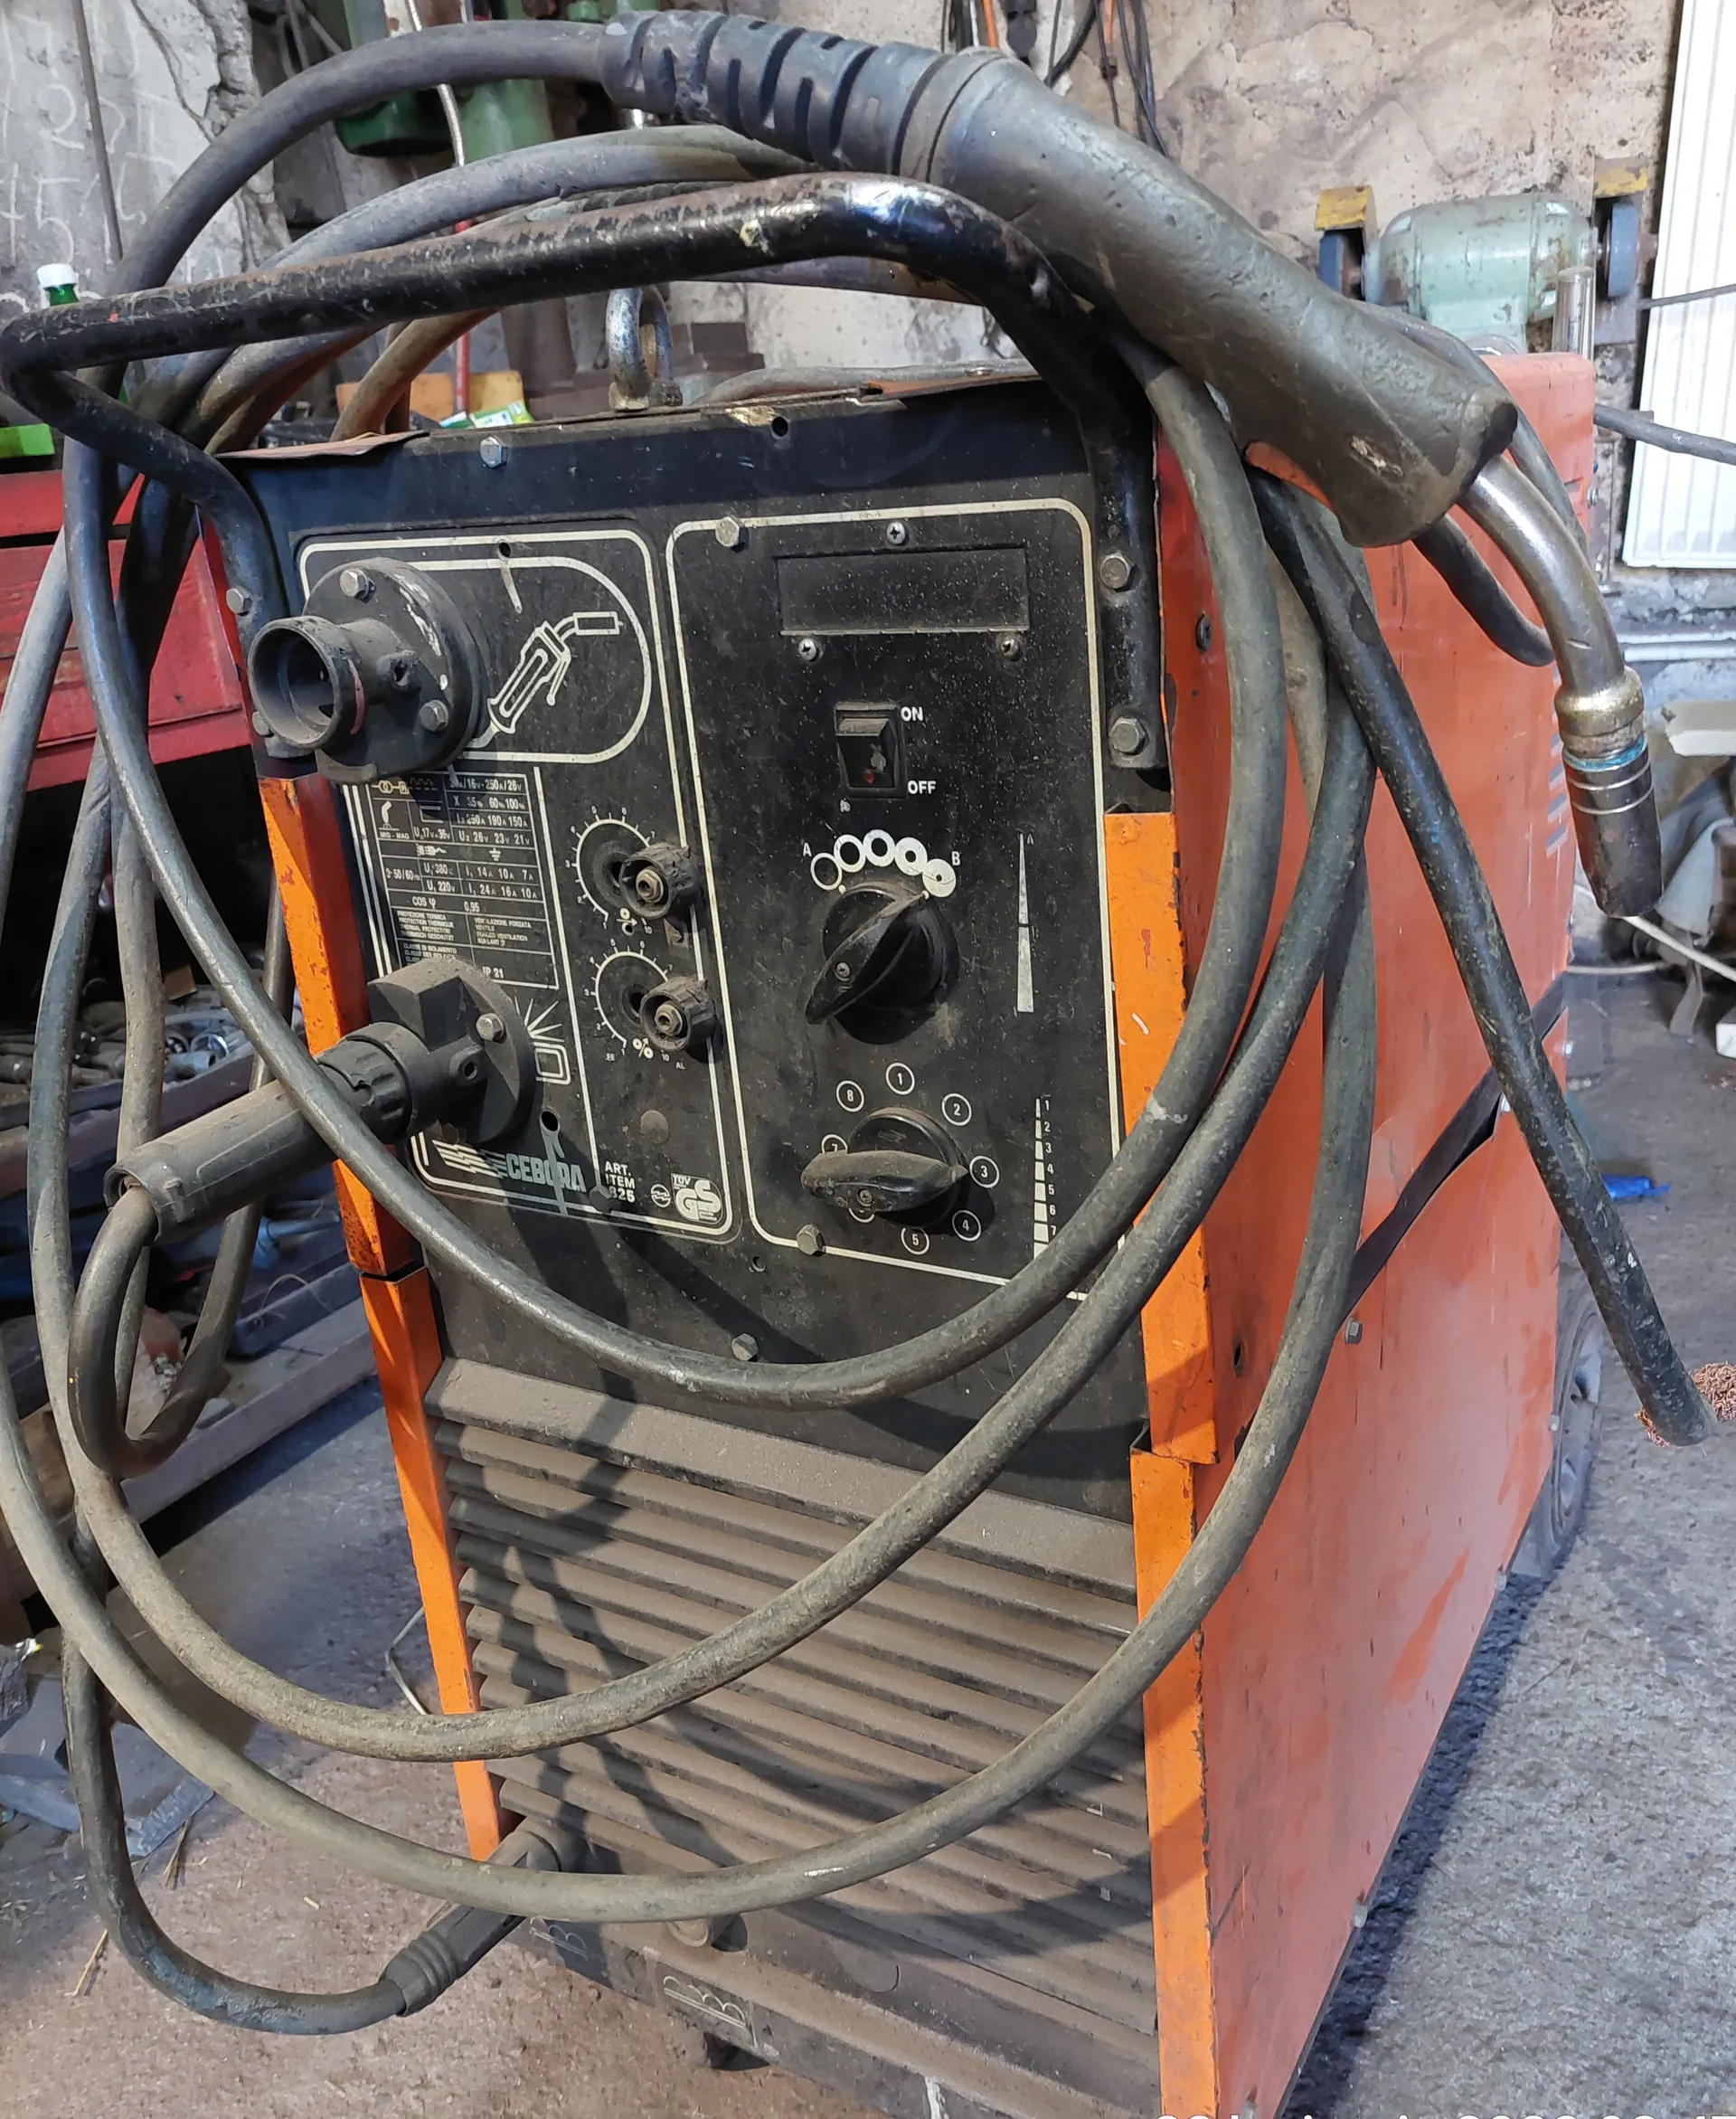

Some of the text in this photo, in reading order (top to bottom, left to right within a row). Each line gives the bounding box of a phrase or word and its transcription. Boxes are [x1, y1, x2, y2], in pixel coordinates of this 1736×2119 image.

[901, 706, 924, 722] ON
[907, 780, 937, 795] OFF
[487, 814, 507, 827] 190A
[508, 816, 528, 828] 150A
[802, 841, 813, 858] A
[952, 850, 961, 866] B
[412, 896, 427, 907] COS
[897, 1073, 904, 1086] 1
[846, 1089, 854, 1102] 8
[954, 1102, 961, 1115] 2
[1044, 1100, 1050, 1111] 1
[1043, 1121, 1052, 1132] 2
[1045, 1142, 1052, 1153] 3
[604, 1160, 632, 1178] ART.
[981, 1165, 988, 1178] 3
[1047, 1163, 1054, 1175] 4
[605, 1174, 636, 1189] ITEM
[1047, 1184, 1054, 1196] 5
[1049, 1204, 1056, 1216] 6
[962, 1218, 970, 1231] 4
[1050, 1225, 1057, 1236] 7
[911, 1234, 919, 1246] 5
